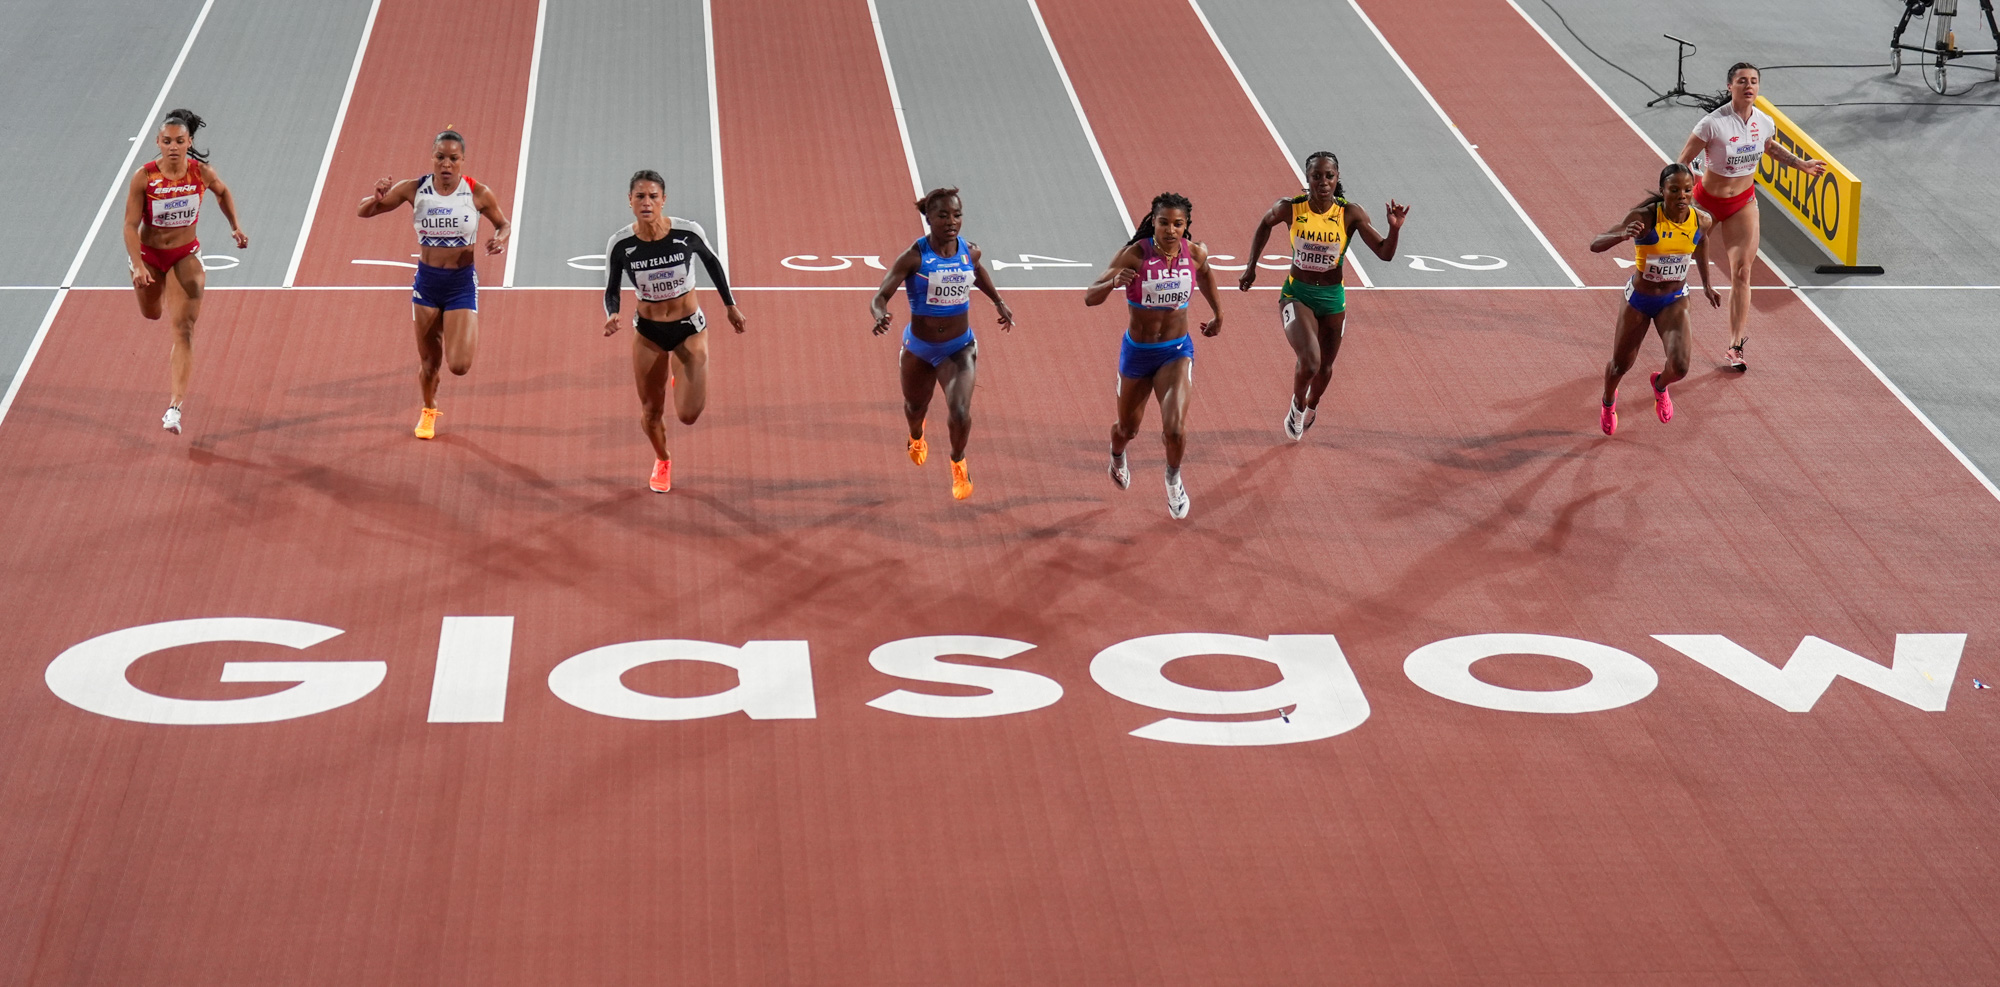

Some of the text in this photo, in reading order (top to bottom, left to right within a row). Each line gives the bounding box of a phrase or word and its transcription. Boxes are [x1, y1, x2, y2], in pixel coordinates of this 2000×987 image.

[1727, 151, 1763, 165] STEFANOWIC
[154, 184, 198, 194] ESPAÑA
[1757, 125, 1840, 241] SEIKO
[421, 217, 459, 228] OLIERE
[1296, 229, 1341, 243] JAMAICA
[630, 252, 685, 270] NEW ZEALAND
[780, 255, 888, 272] 5
[990, 253, 1094, 271] 4
[1296, 248, 1336, 265] FORBES
[1403, 254, 1508, 272] 2
[1146, 268, 1193, 281] USA
[1649, 264, 1687, 275] EVELYN
[640, 277, 685, 293] Z. HOBBS
[1145, 290, 1189, 304] A. HOBBS
[44, 615, 1968, 747] Glasgow
